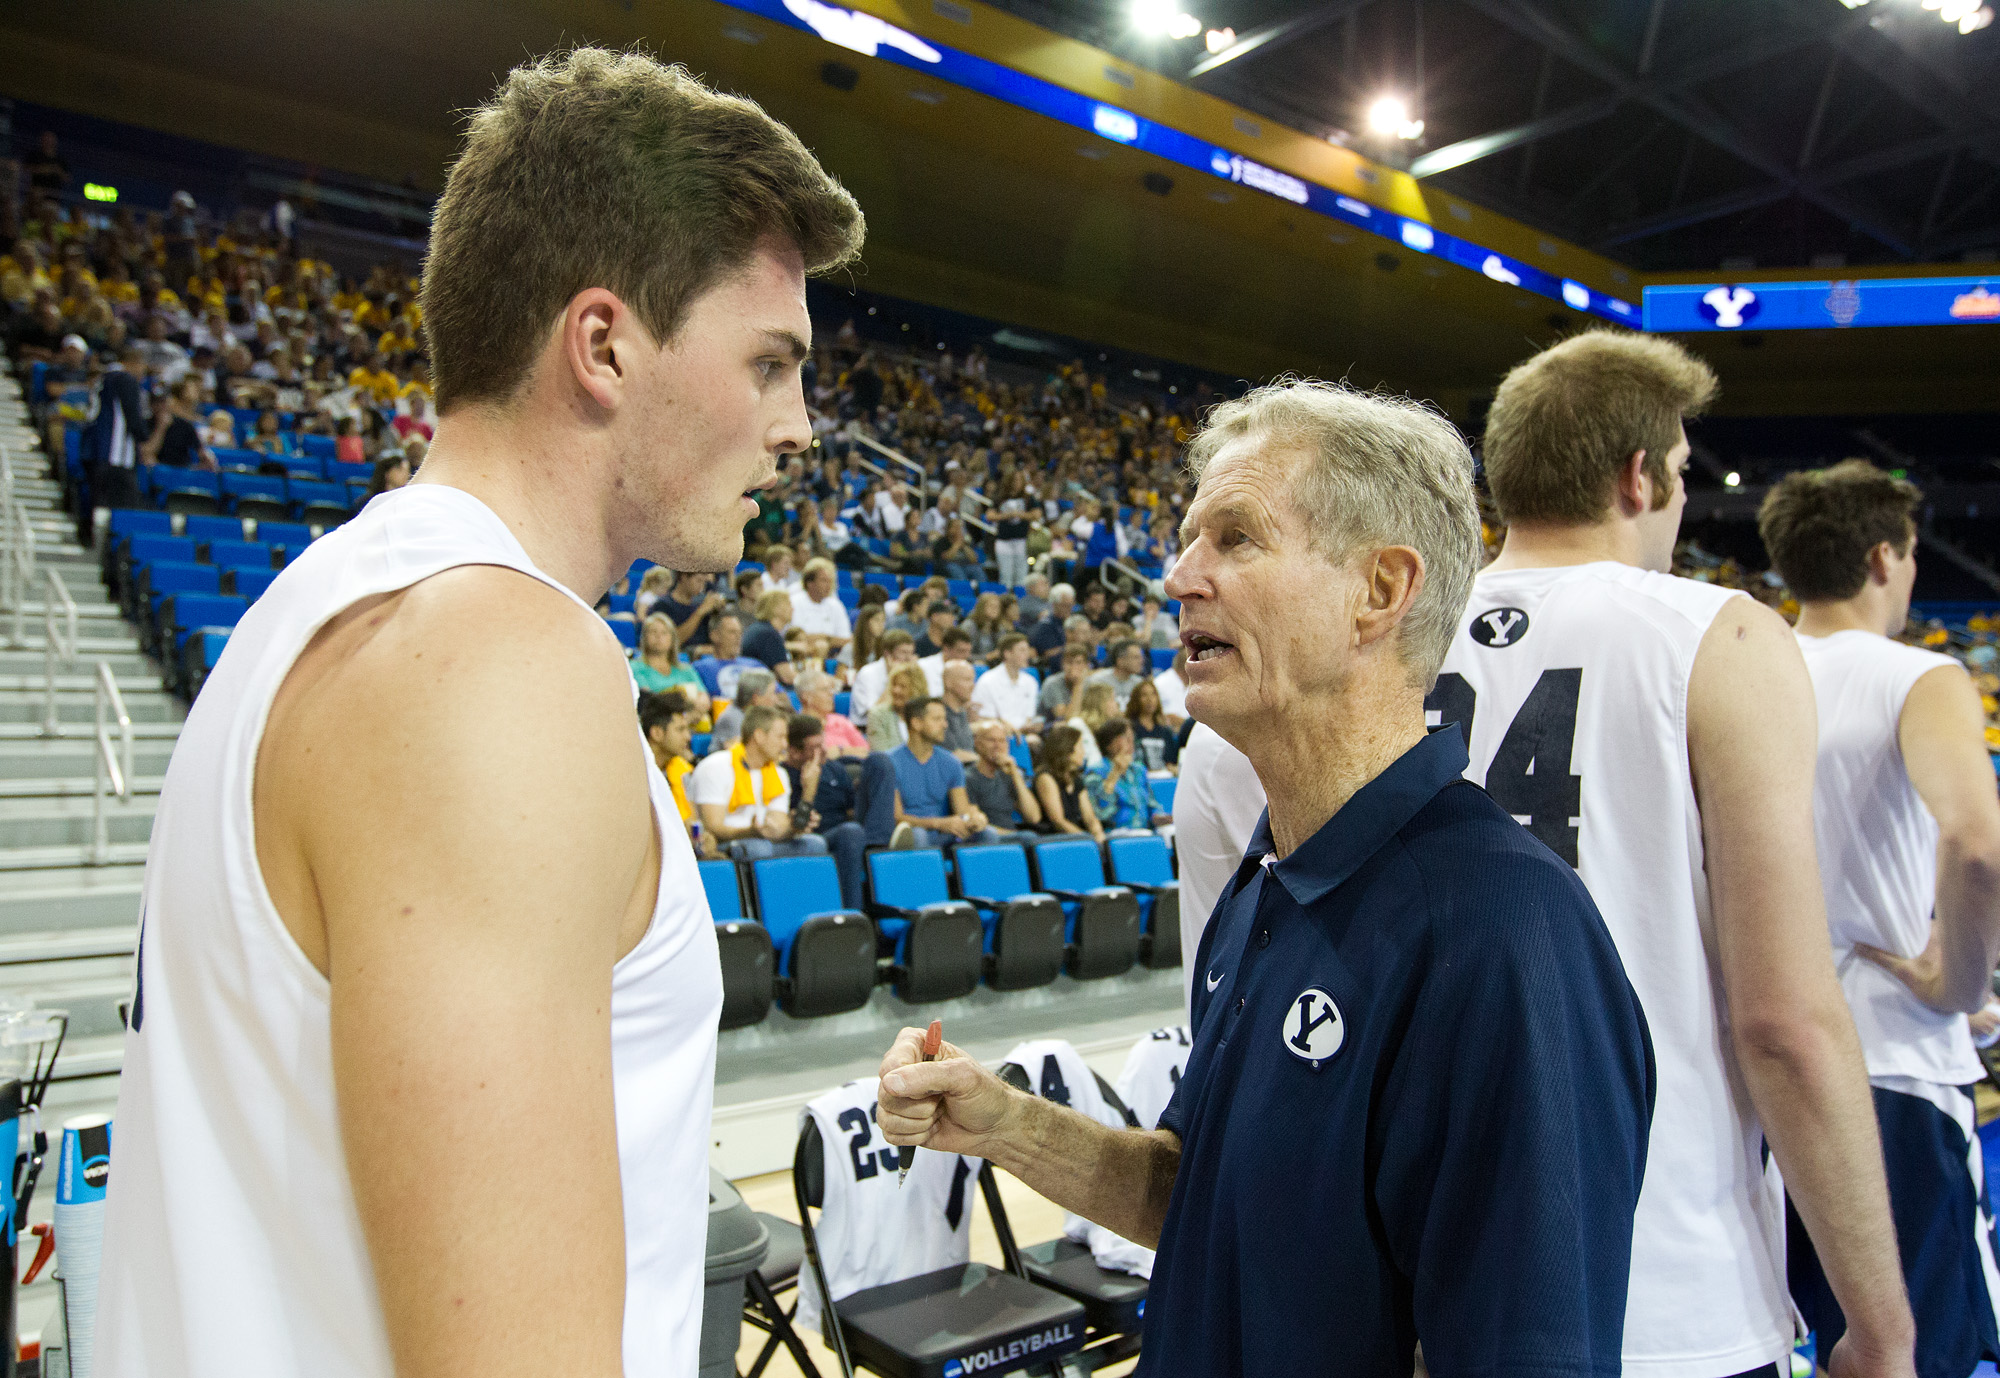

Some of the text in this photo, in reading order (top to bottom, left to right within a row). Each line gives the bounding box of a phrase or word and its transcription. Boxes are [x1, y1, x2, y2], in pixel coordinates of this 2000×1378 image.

[1703, 287, 1755, 328] Y
[1482, 610, 1523, 645] Y
[1290, 994, 1337, 1053] Y
[961, 1323, 1075, 1374] VOLLEYBALL
